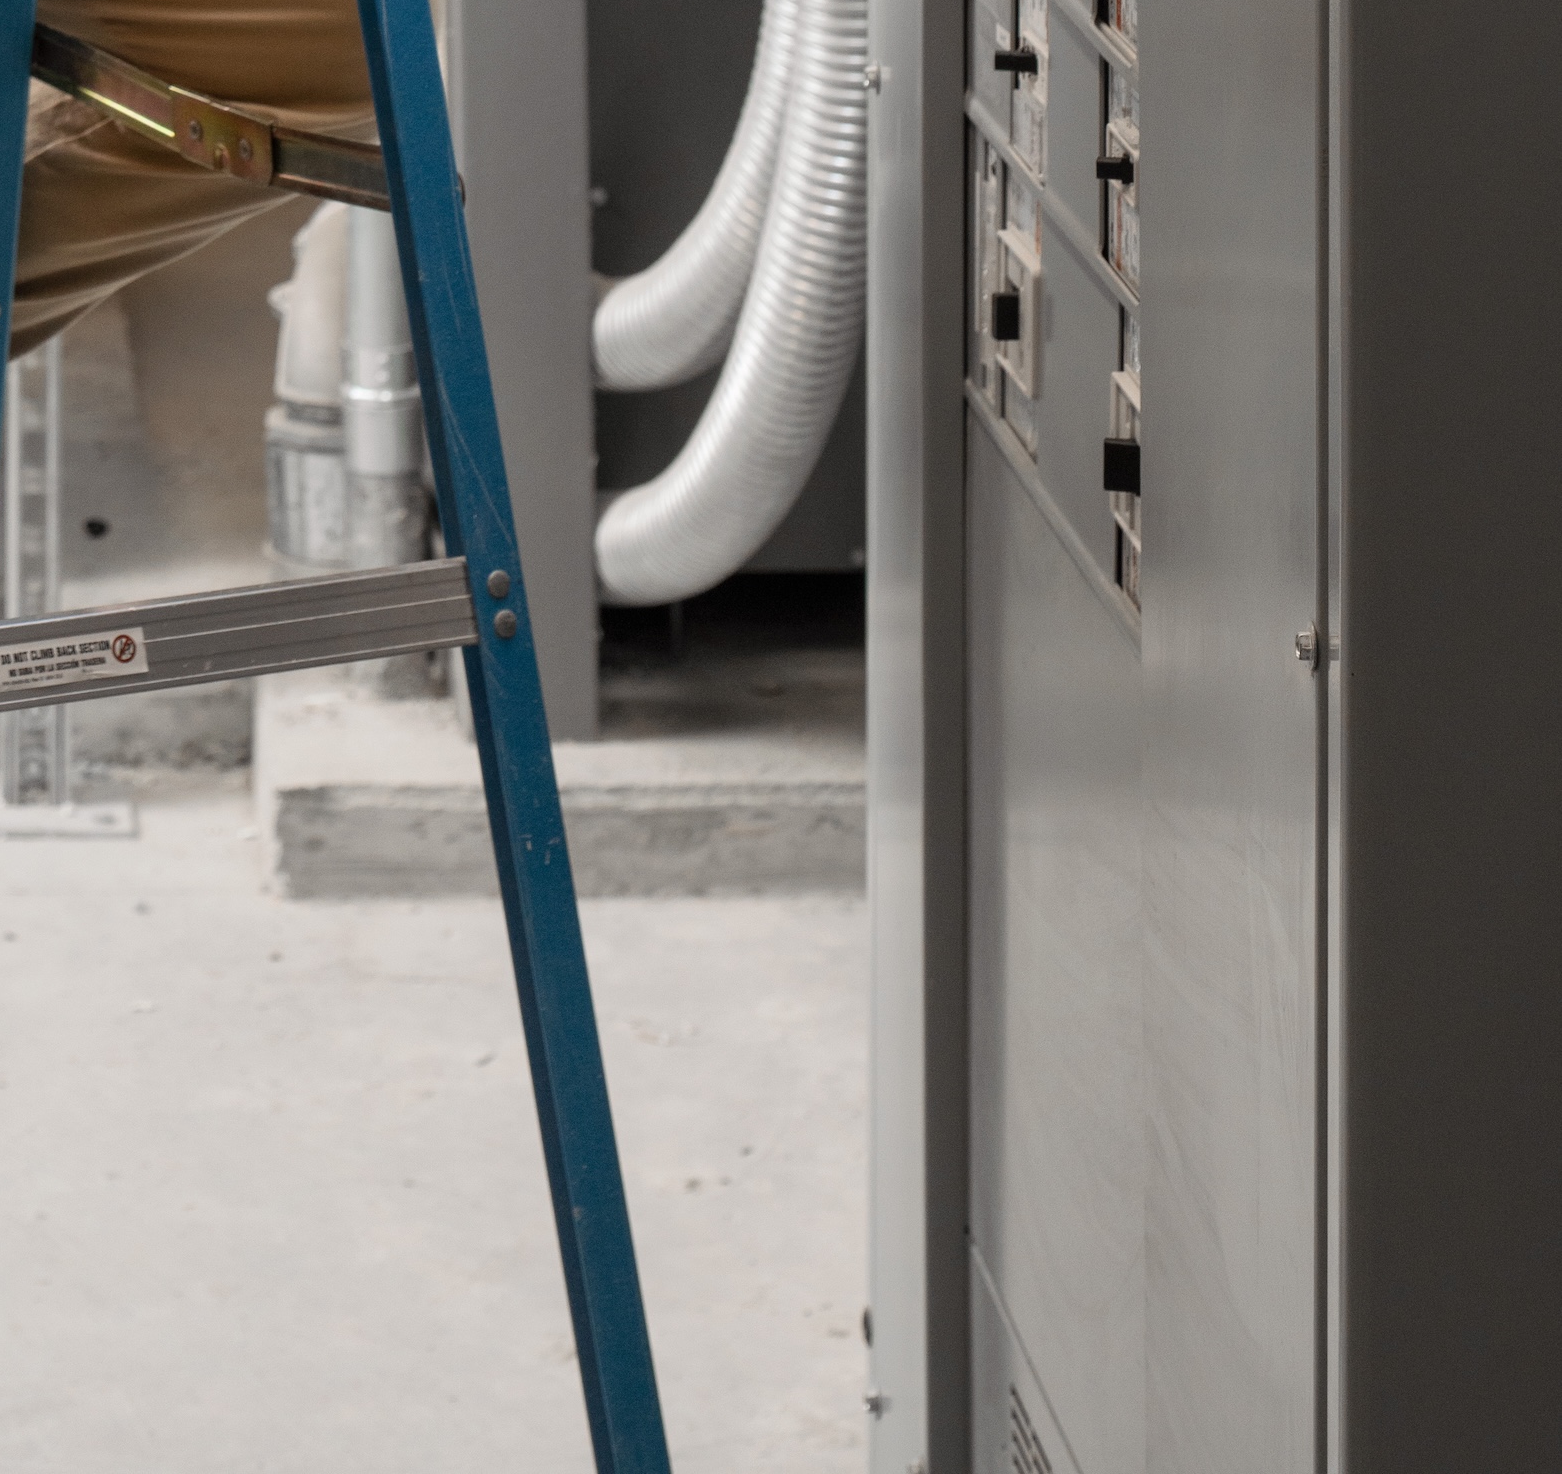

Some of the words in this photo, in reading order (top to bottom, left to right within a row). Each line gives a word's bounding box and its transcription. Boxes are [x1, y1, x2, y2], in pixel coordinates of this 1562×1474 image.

[1, 654, 12, 665] DO
[13, 651, 28, 663] NOT
[30, 648, 54, 661] CLIMB
[56, 644, 77, 657] BACK
[79, 640, 110, 654] SECTION
